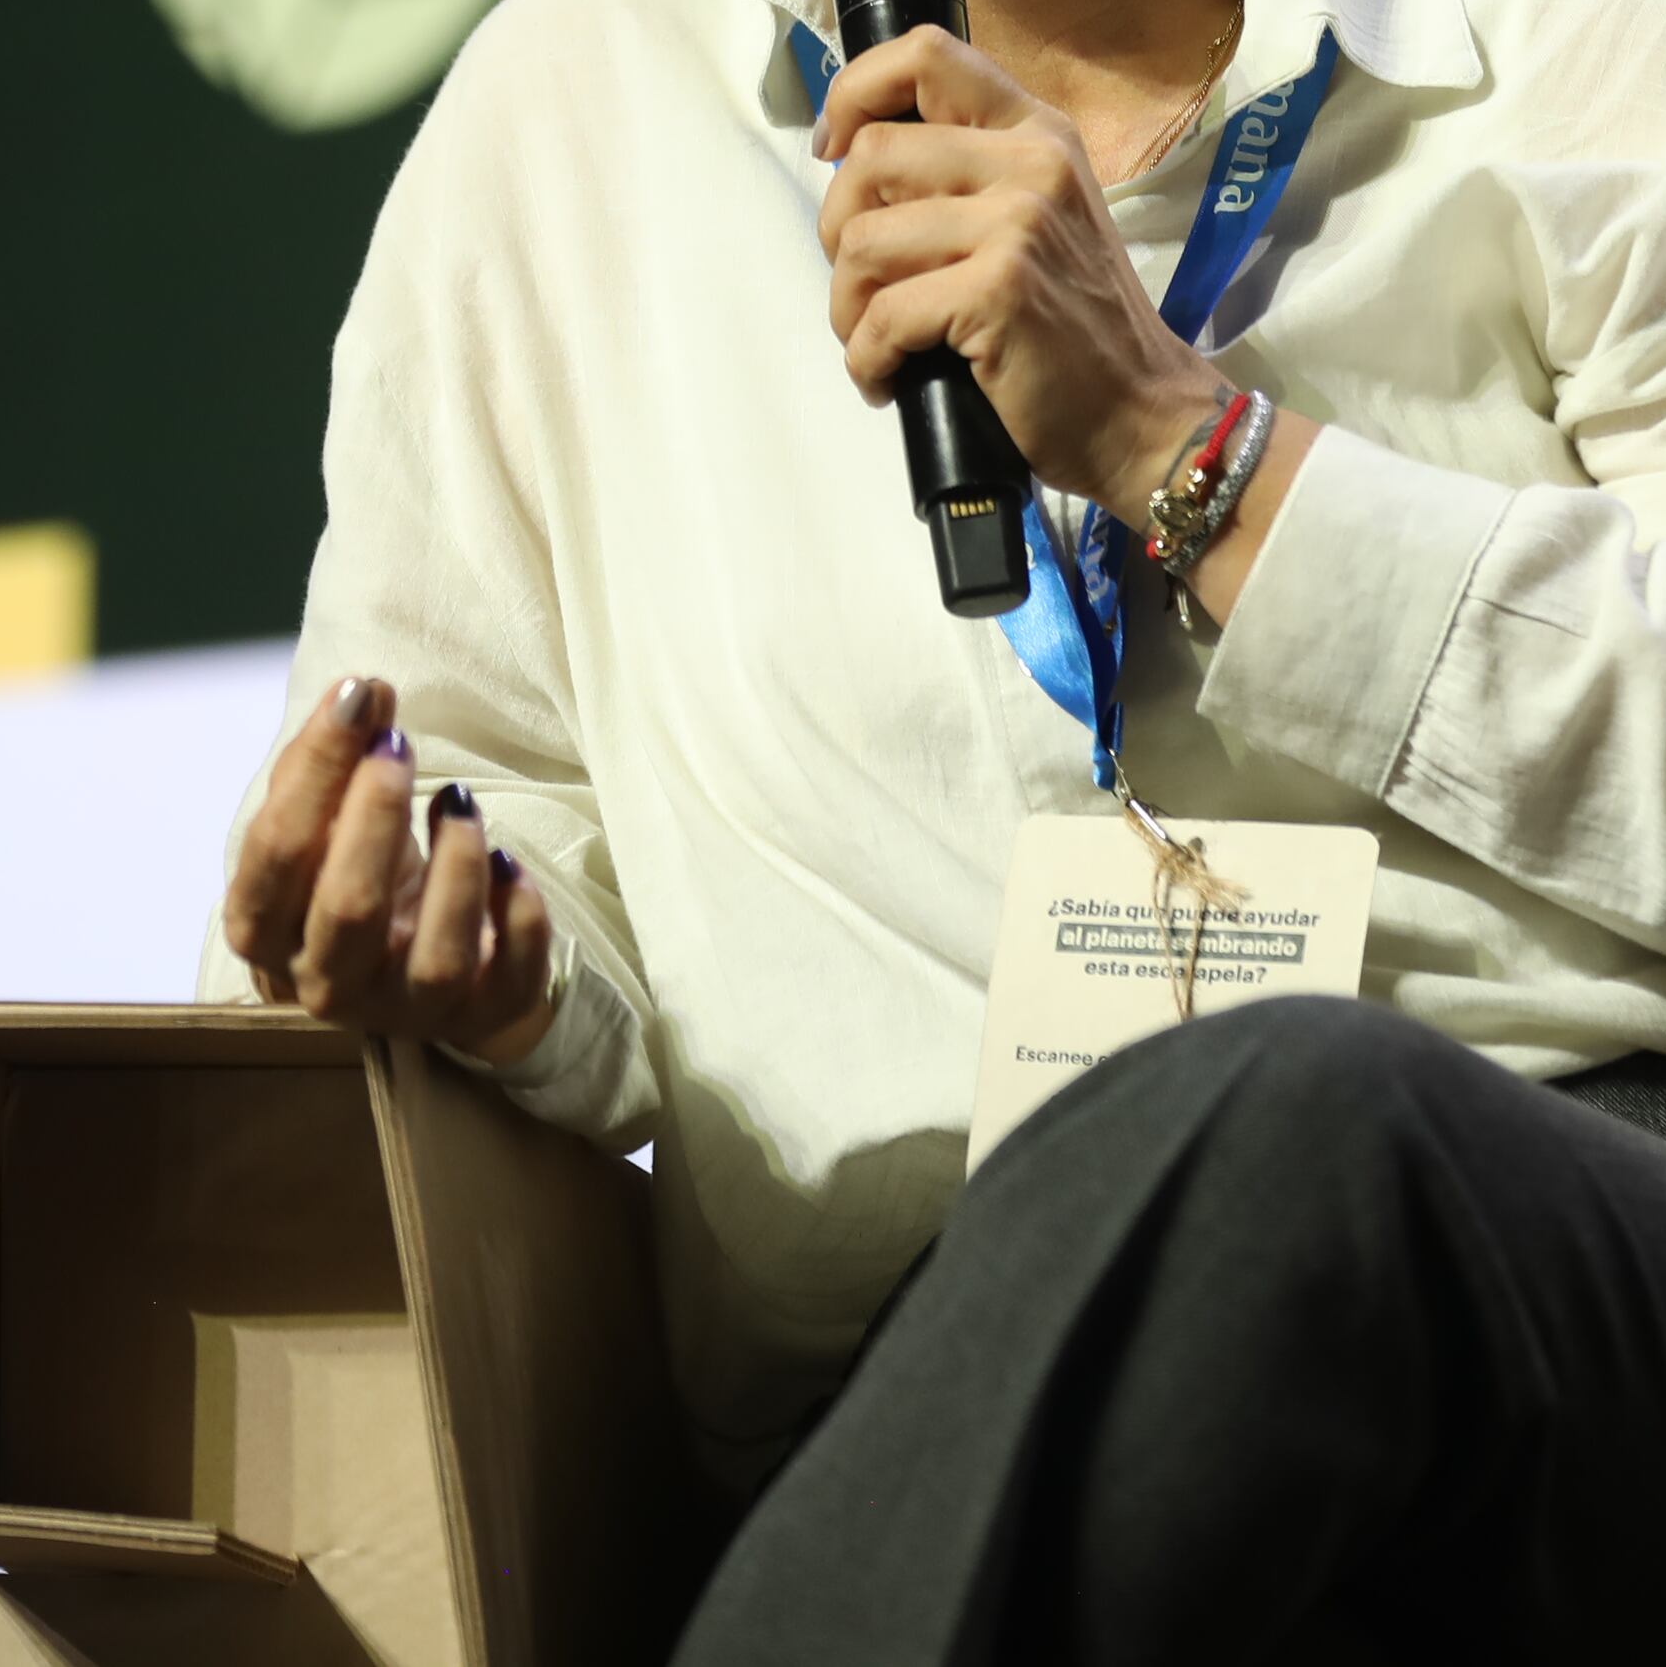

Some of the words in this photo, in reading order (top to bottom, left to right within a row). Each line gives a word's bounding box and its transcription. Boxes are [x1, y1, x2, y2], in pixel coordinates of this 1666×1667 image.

[1048, 898, 1120, 917] ¿Sabía
[1245, 908, 1320, 928] ayudar
[1061, 927, 1081, 946] al
[1085, 961, 1130, 976] esta
[1135, 964, 1268, 984] escaapela?
[1016, 1046, 1093, 1066] Escanee
